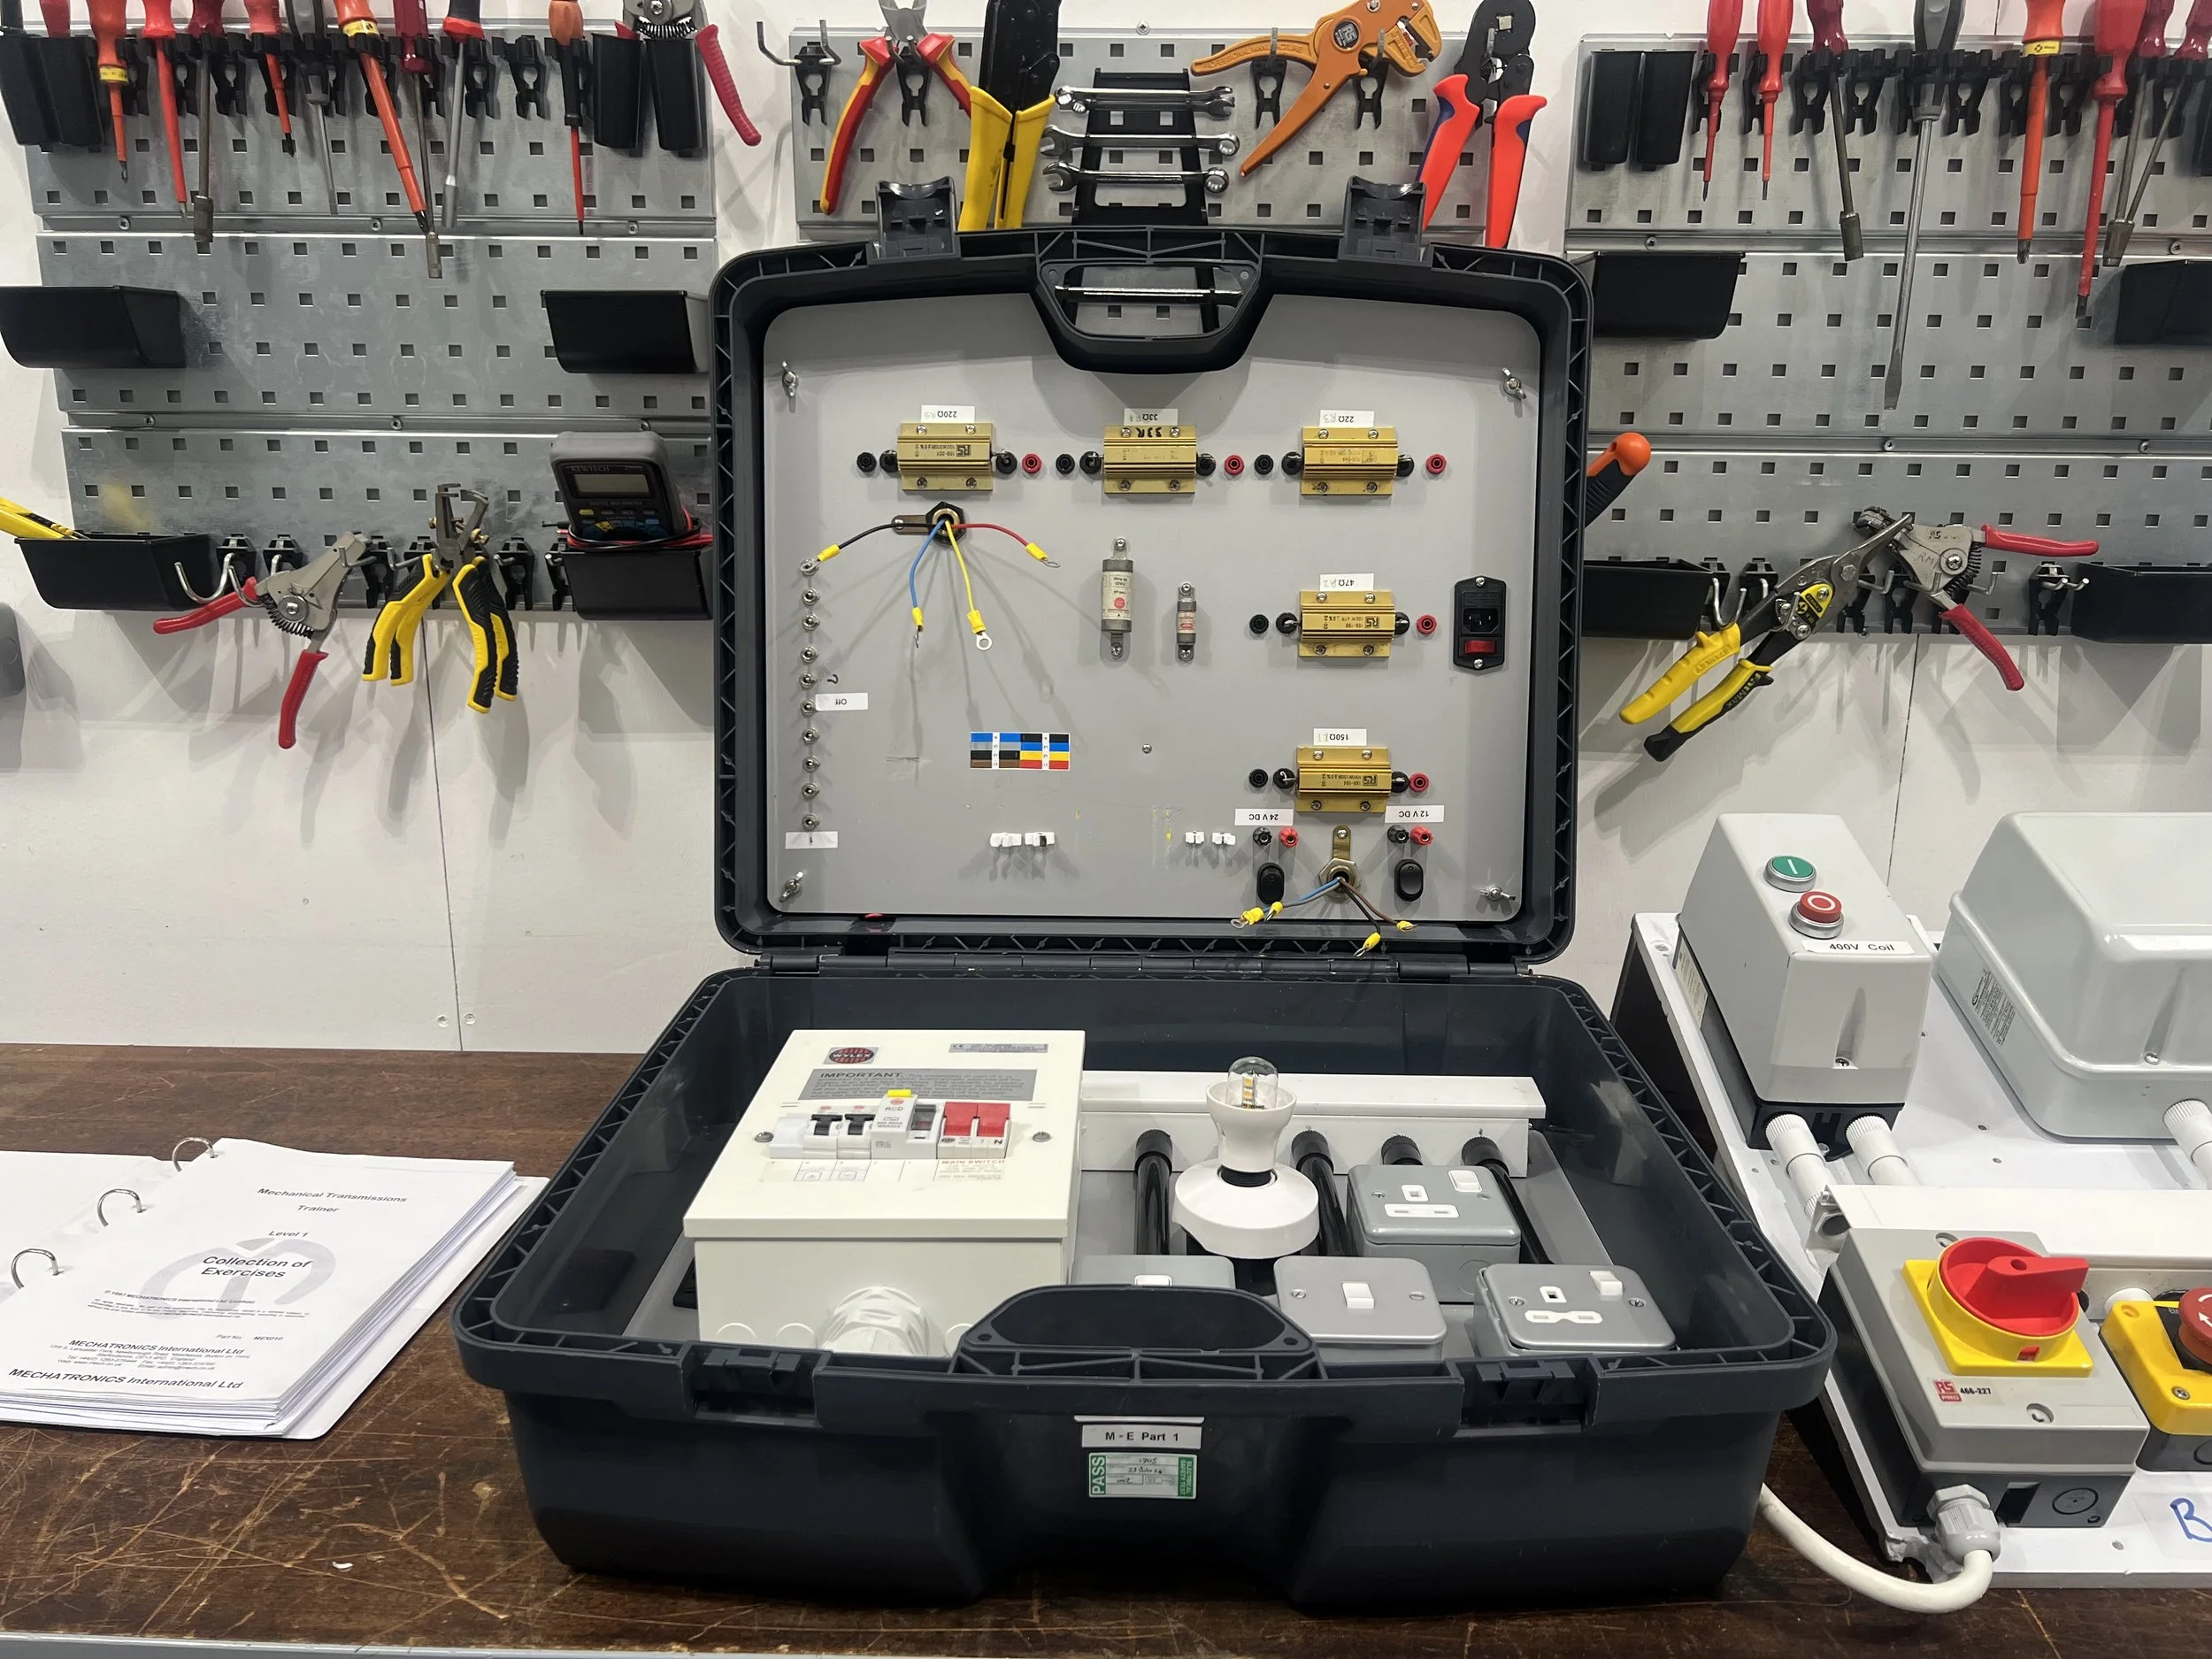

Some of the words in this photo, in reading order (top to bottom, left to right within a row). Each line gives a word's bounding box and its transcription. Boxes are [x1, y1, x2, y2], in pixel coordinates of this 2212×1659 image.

[1135, 426, 1162, 438] 33R
[257, 1188, 324, 1198] Mechanical
[326, 1192, 408, 1202] Transmissions
[203, 1256, 288, 1267] Collection
[201, 1267, 286, 1278] Exercises
[69, 1340, 157, 1351] MECHATRONICS
[158, 1345, 226, 1354] International
[9, 1369, 127, 1383] MECHATRONICS
[127, 1377, 219, 1387] International
[1934, 1380, 1957, 1394] RS
[1106, 1432, 1115, 1440] M
[1127, 1432, 1134, 1440] E
[1141, 1432, 1166, 1441] Part
[1173, 1432, 1179, 1441] 1
[1092, 1456, 1105, 1494] PASS
